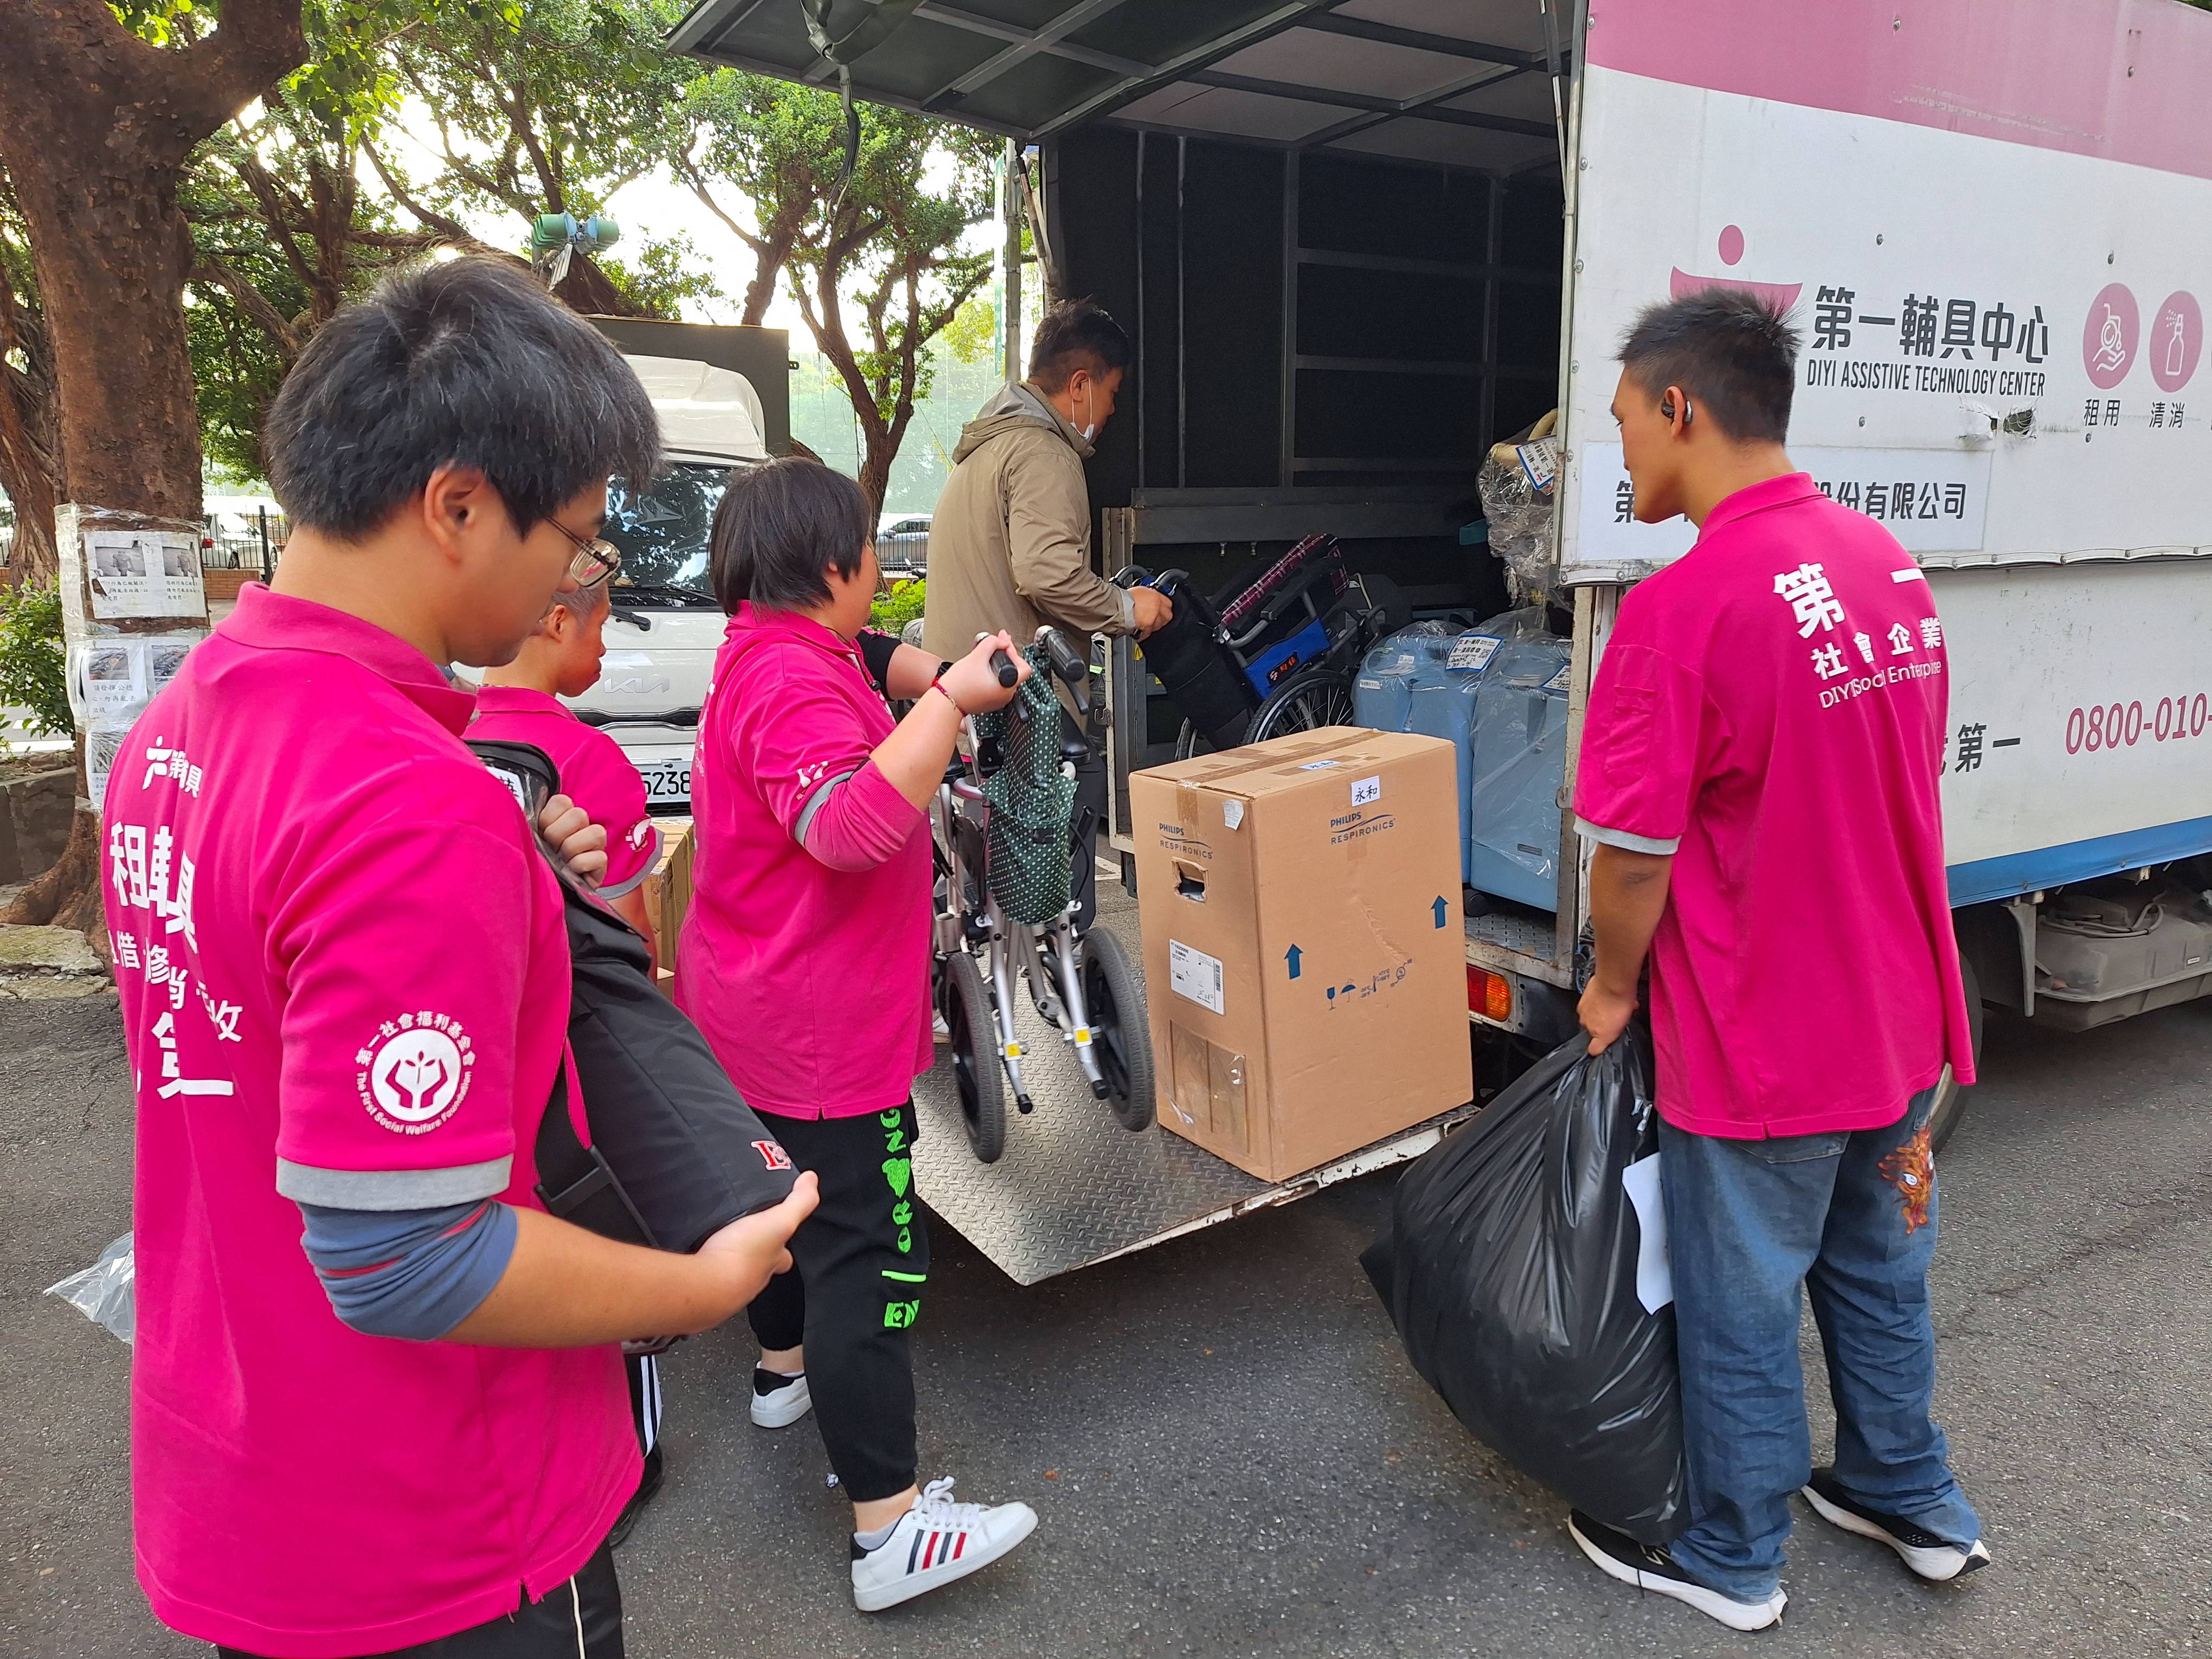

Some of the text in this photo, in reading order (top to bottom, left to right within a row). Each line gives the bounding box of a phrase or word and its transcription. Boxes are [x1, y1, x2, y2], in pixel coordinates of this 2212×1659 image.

[1811, 285, 2049, 364] 第一輔具中心
[1807, 359, 2046, 396] DIYI ASSISTIVE TECHNOLOGY CENTER
[2084, 398, 2120, 427] 租用
[2149, 402, 2185, 428] 清消
[1773, 563, 1925, 639] 第一
[1810, 617, 1941, 680] 社會企業
[1852, 670, 1886, 695] Socl
[1940, 722, 2021, 775] 第一
[1355, 785, 1378, 802] 永和
[1159, 823, 1184, 835] PHILIPS
[1330, 812, 1361, 828] PHILIPS
[1331, 820, 1394, 845] RESPIRONICS
[1160, 840, 1212, 859] RESPIRONICS
[108, 930, 141, 969] 借
[355, 1011, 475, 1066] 第一社會福利基金會
[357, 1071, 368, 1091] The
[360, 1091, 378, 1116] First
[374, 1112, 405, 1133] Social
[405, 1118, 442, 1135] Welfare
